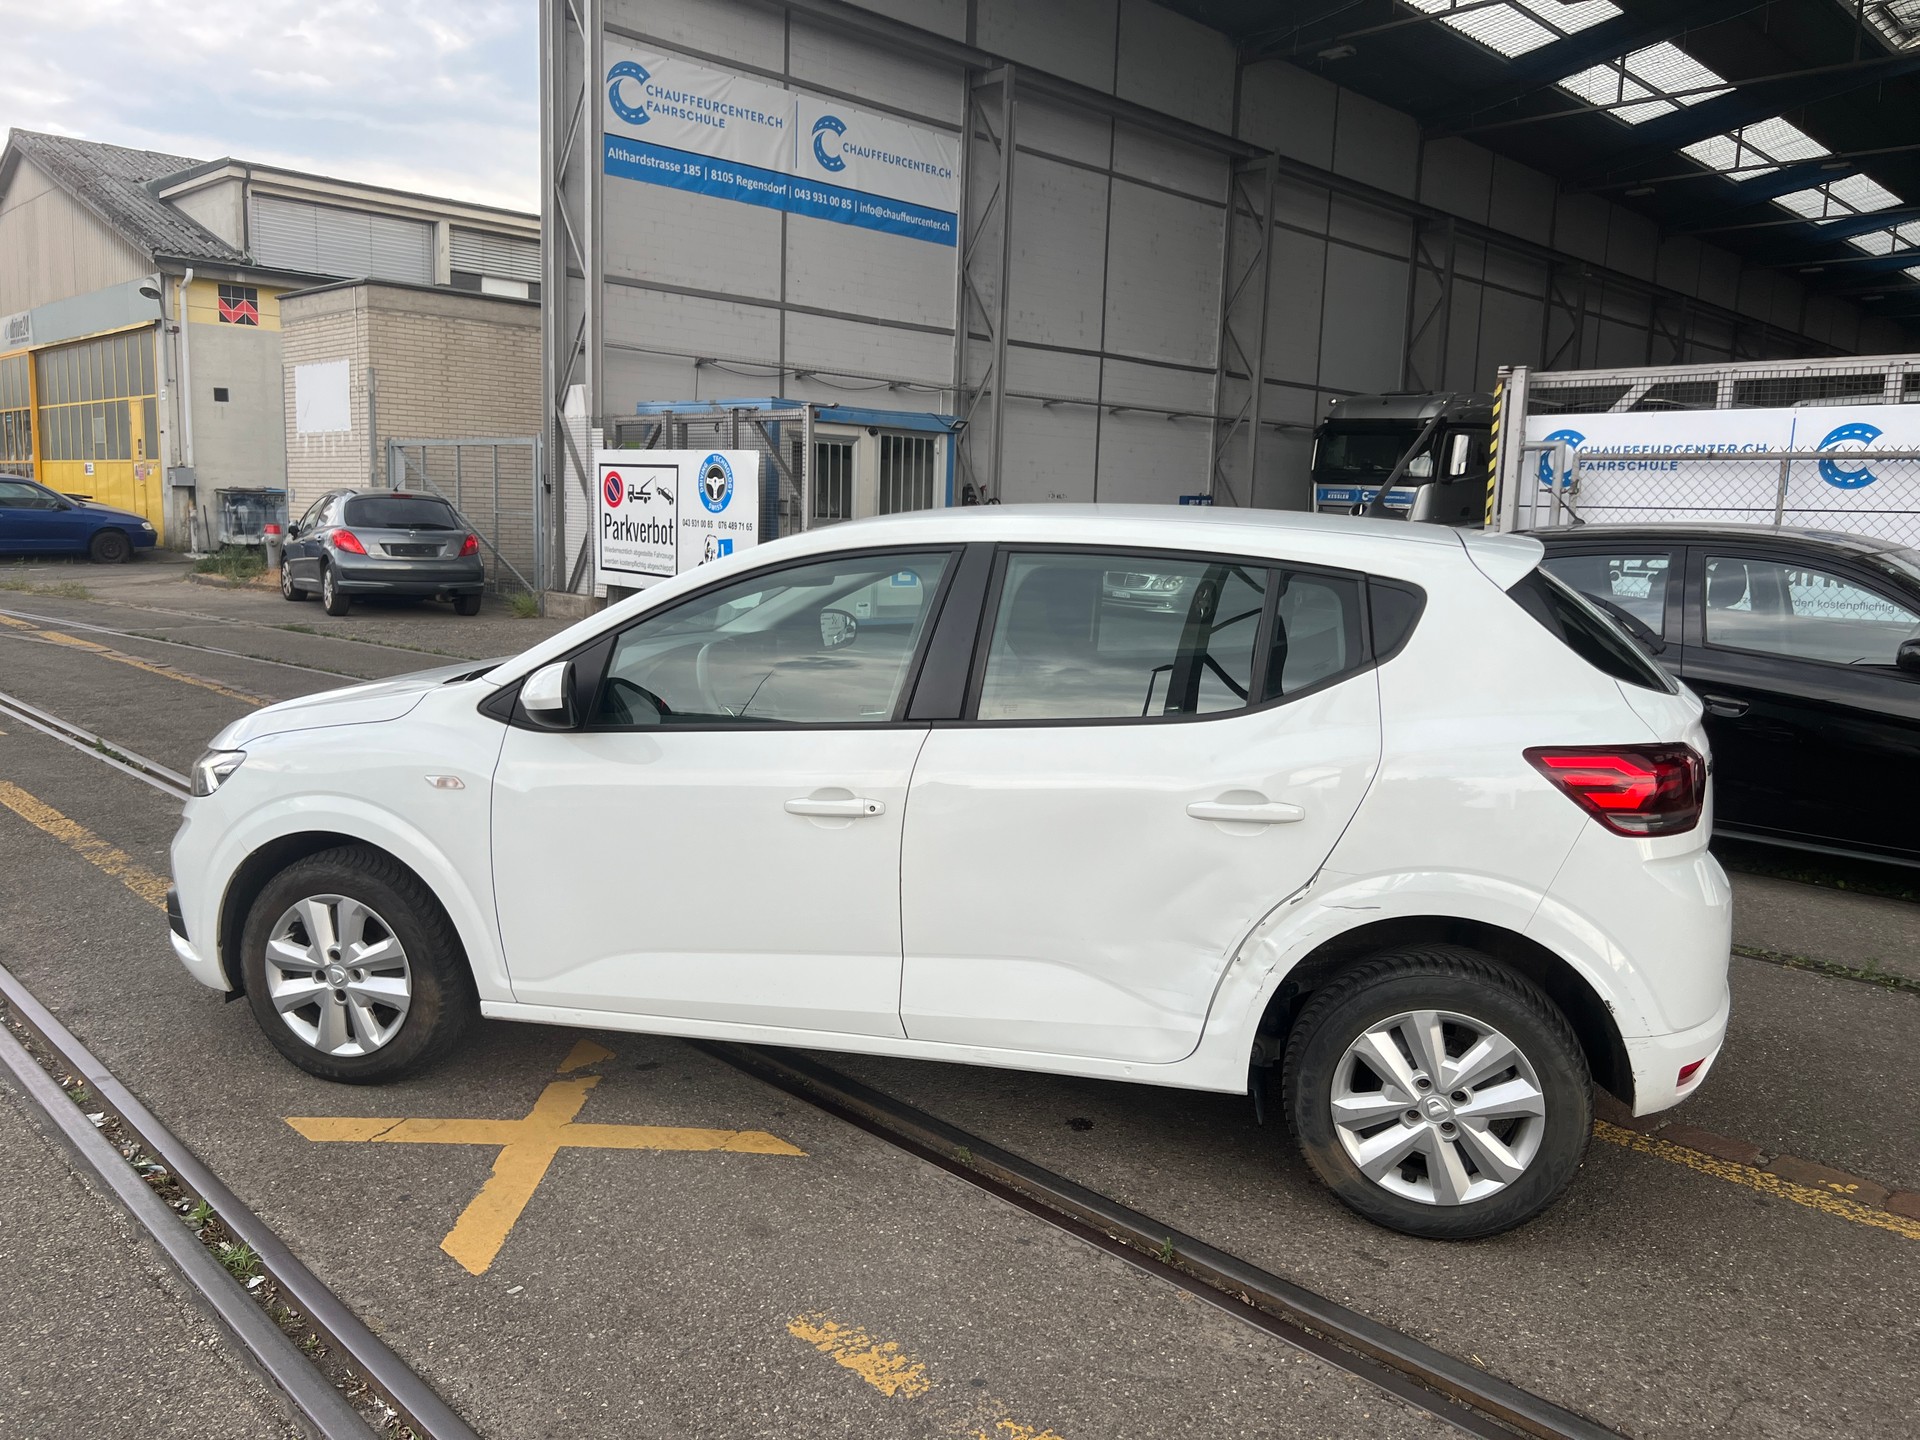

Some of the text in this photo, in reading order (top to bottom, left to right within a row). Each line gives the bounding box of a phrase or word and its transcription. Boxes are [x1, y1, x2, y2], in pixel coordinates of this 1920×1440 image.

[646, 84, 783, 129] CHAUFFEURCENTER.CH
[646, 100, 726, 129] FAHRSCHULE
[842, 142, 952, 179] CHAUFFEURCENTER.CH
[607, 147, 950, 232] Althardstrasse 185 8105 Regensdorf 043 931 00 85 info@chauffeurcenter.ch
[1578, 461, 1678, 471] FAHRSCHULE
[604, 512, 674, 546] Parkverbot
[1817, 599, 1895, 615] kostenpflichtig
